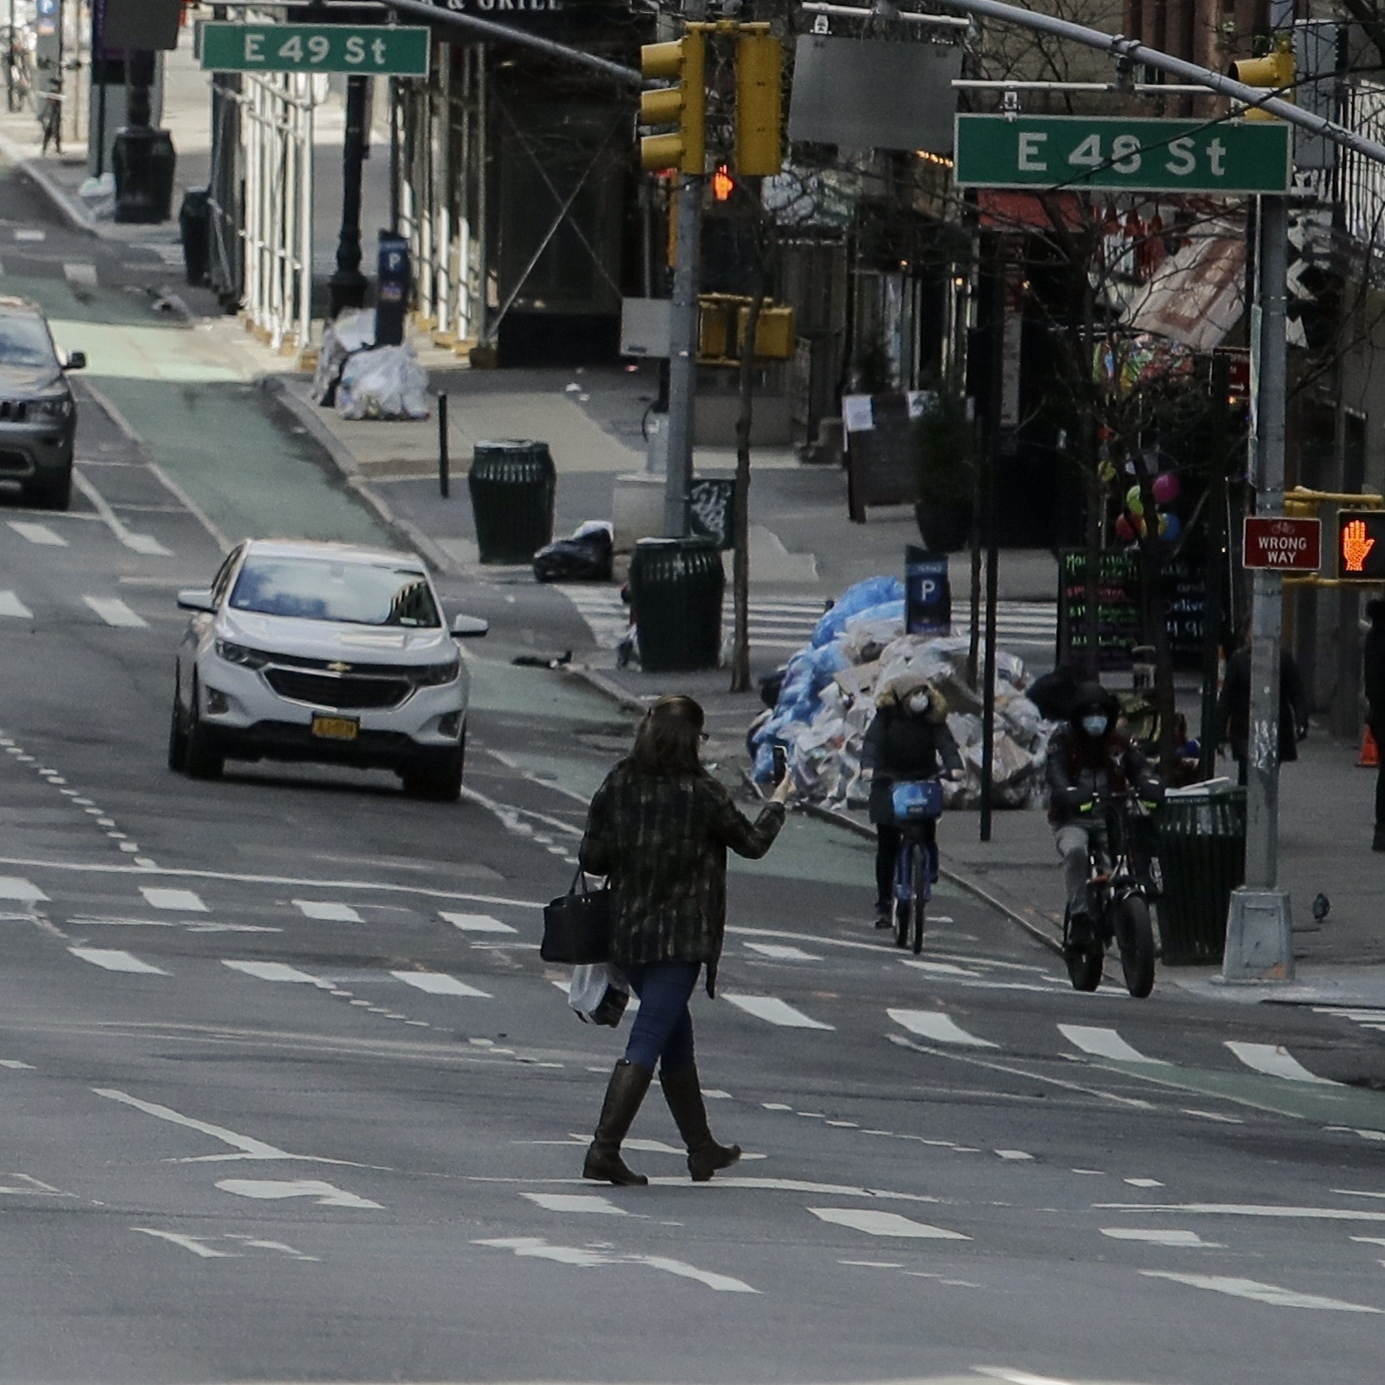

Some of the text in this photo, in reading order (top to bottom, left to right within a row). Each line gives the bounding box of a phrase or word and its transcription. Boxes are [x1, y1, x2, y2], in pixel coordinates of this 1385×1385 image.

[244, 34, 387, 66] E 49 St
[1017, 132, 1227, 177] E 48 St
[388, 252, 401, 271] P
[1258, 536, 1308, 551] WRONG
[1267, 551, 1297, 563] WAY
[921, 580, 936, 602] P
